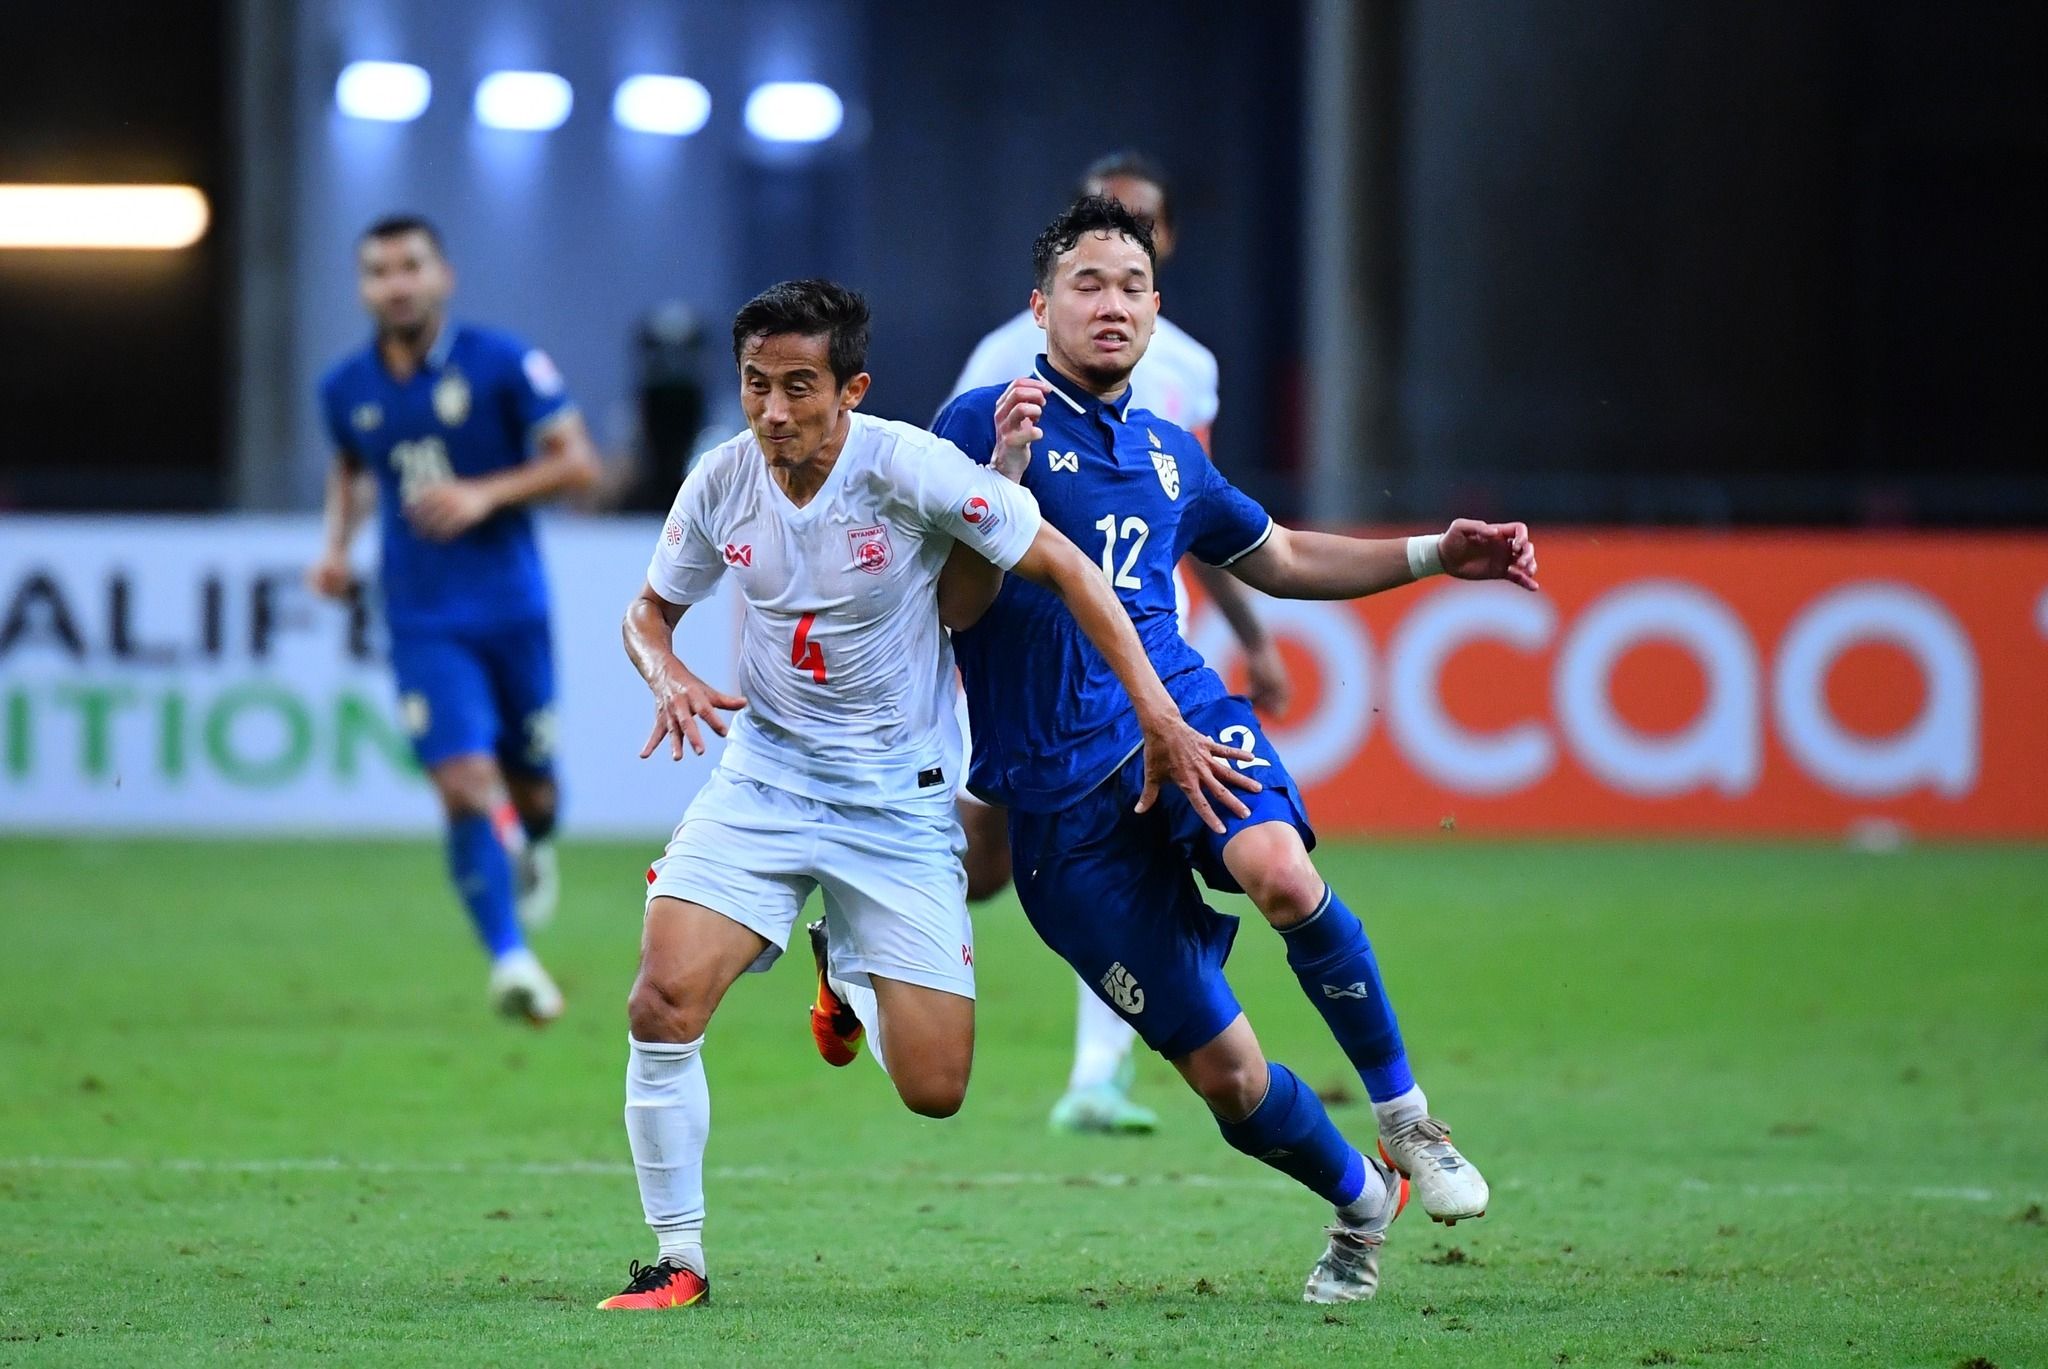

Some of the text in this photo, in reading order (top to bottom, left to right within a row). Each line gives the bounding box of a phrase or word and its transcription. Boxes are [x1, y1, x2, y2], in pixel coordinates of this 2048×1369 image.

[1096, 513, 1150, 590] 12
[792, 612, 828, 685] 4
[1207, 724, 1272, 770] 2
